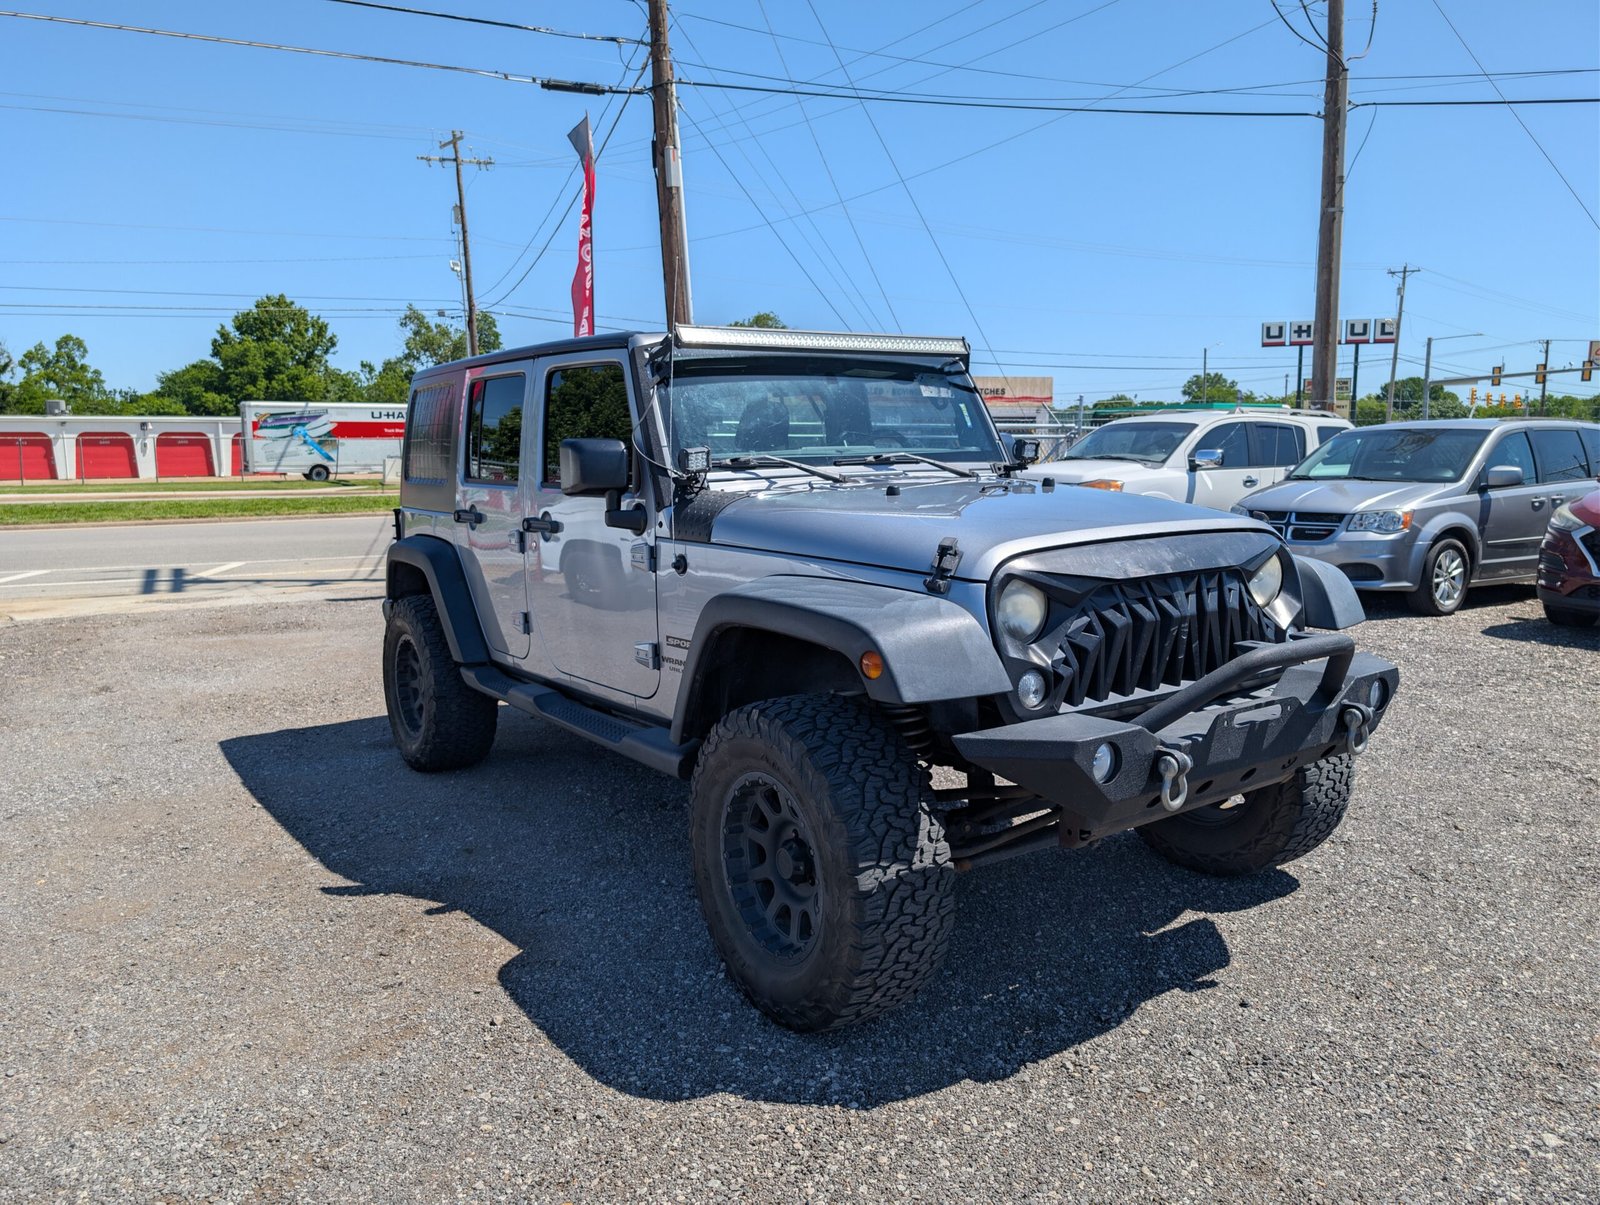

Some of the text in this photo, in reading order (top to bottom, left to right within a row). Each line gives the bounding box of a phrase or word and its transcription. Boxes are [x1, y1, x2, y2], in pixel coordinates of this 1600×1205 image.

[371, 411, 406, 419] U-HA
[667, 637, 691, 648] SPOR
[661, 655, 686, 667] WRAN
